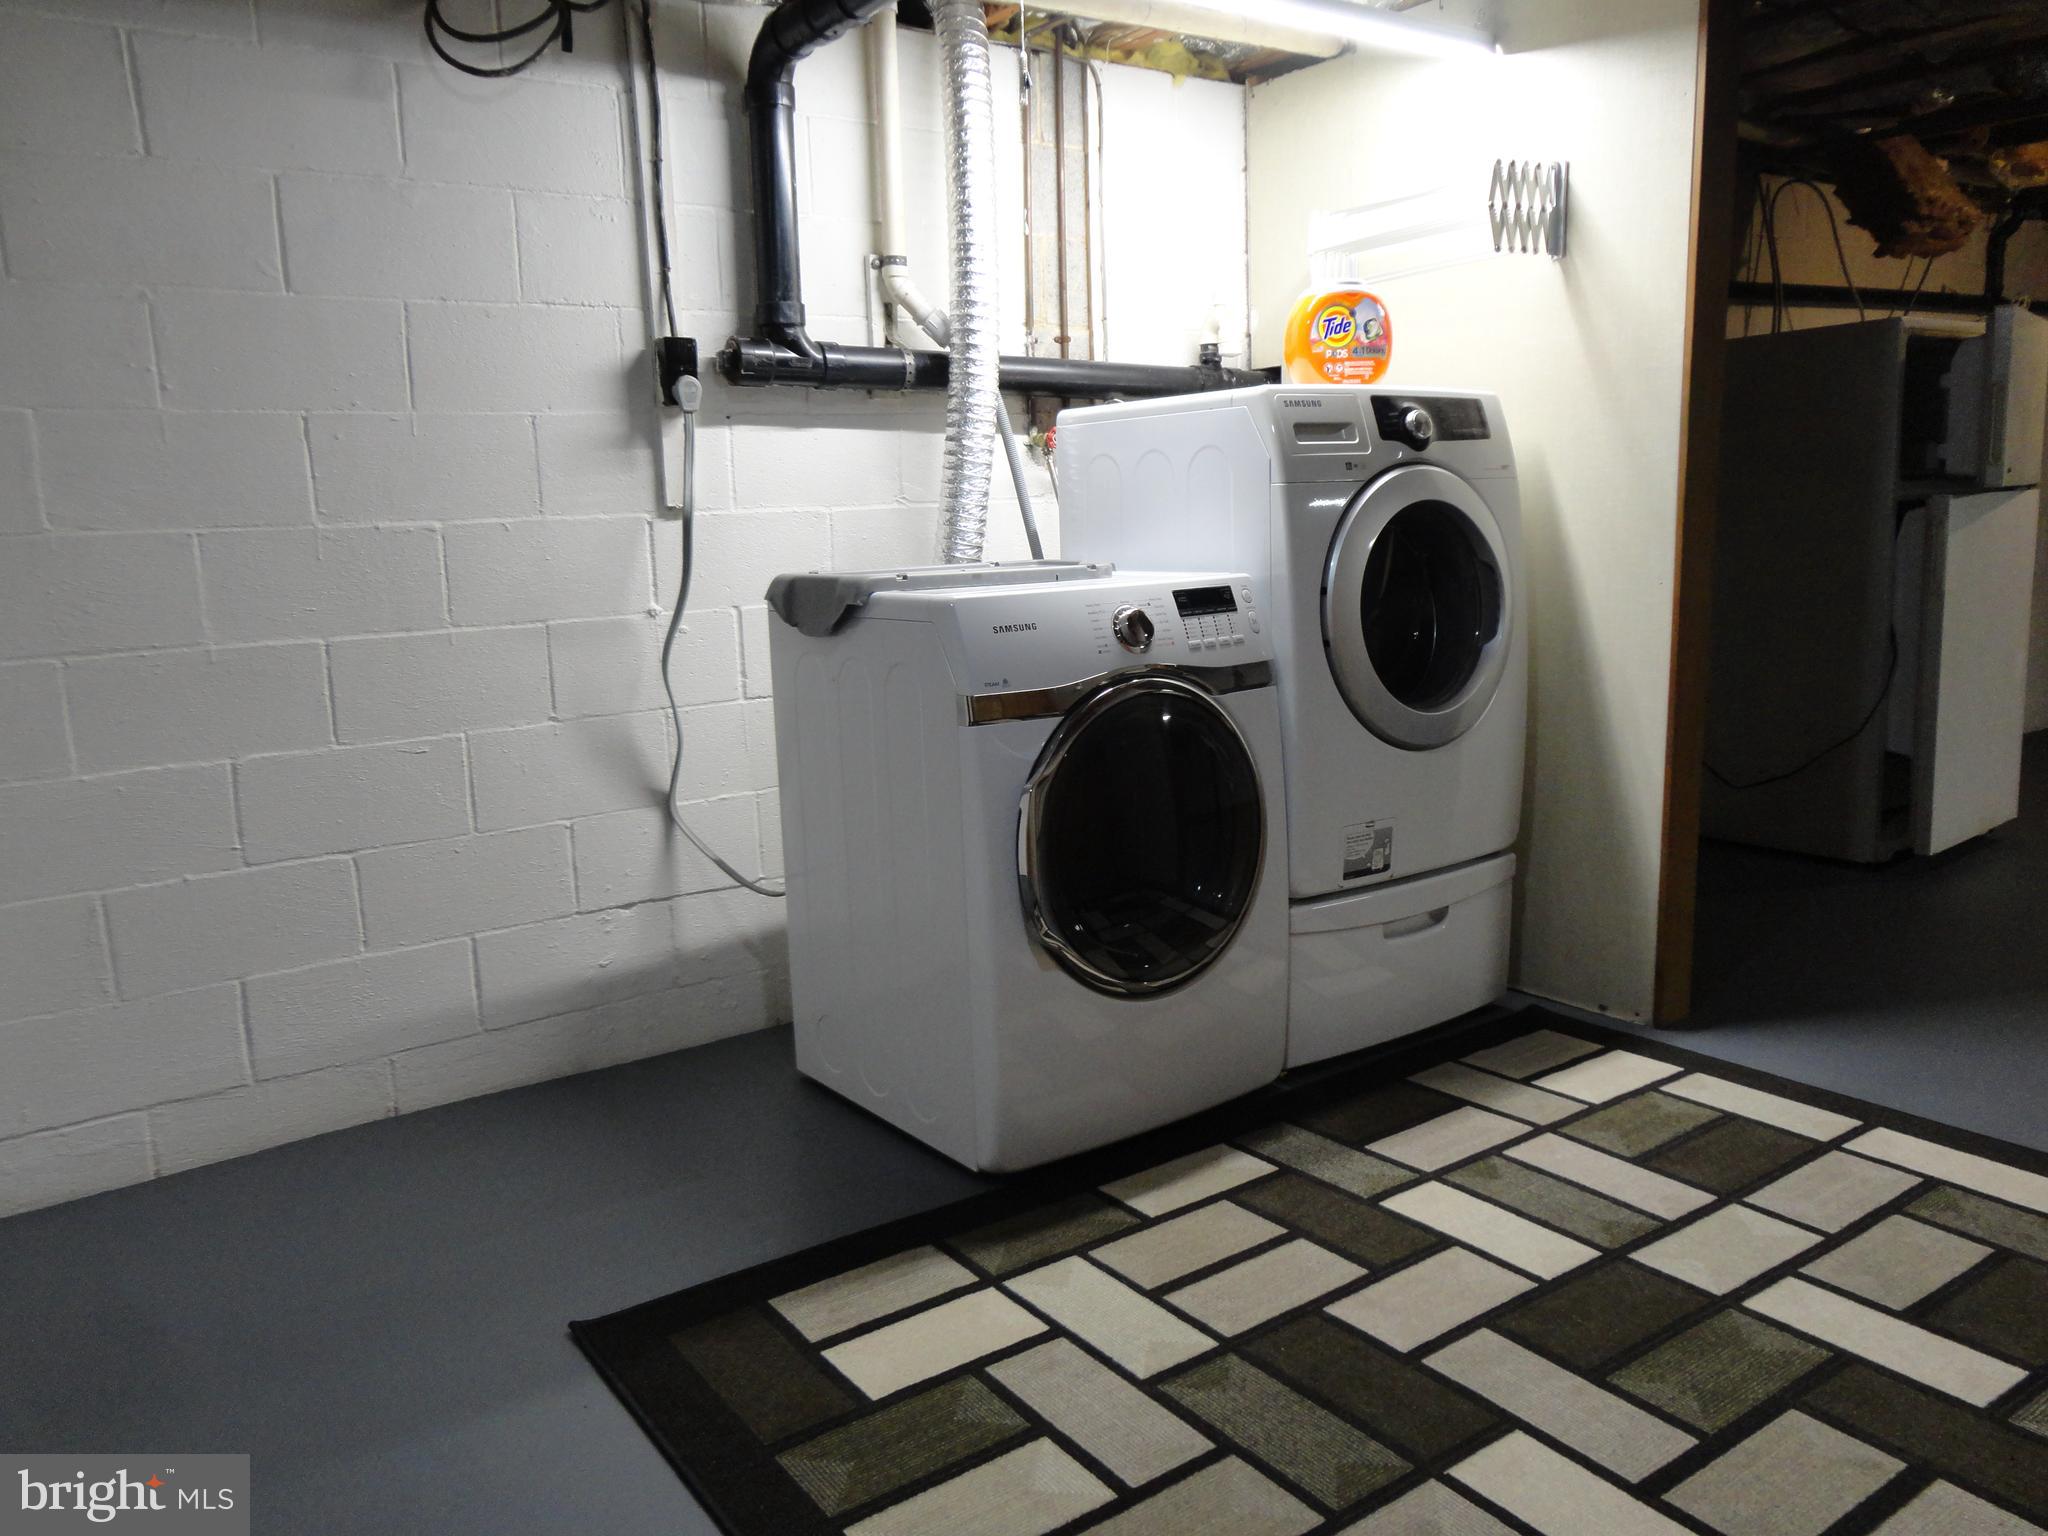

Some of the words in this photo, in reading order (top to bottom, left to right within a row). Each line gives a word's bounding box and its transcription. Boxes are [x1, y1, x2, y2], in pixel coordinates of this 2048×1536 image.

[1323, 316, 1352, 340] Tide
[1283, 399, 1322, 408] SAMSUNG
[992, 622, 1037, 634] SAMSUNG
